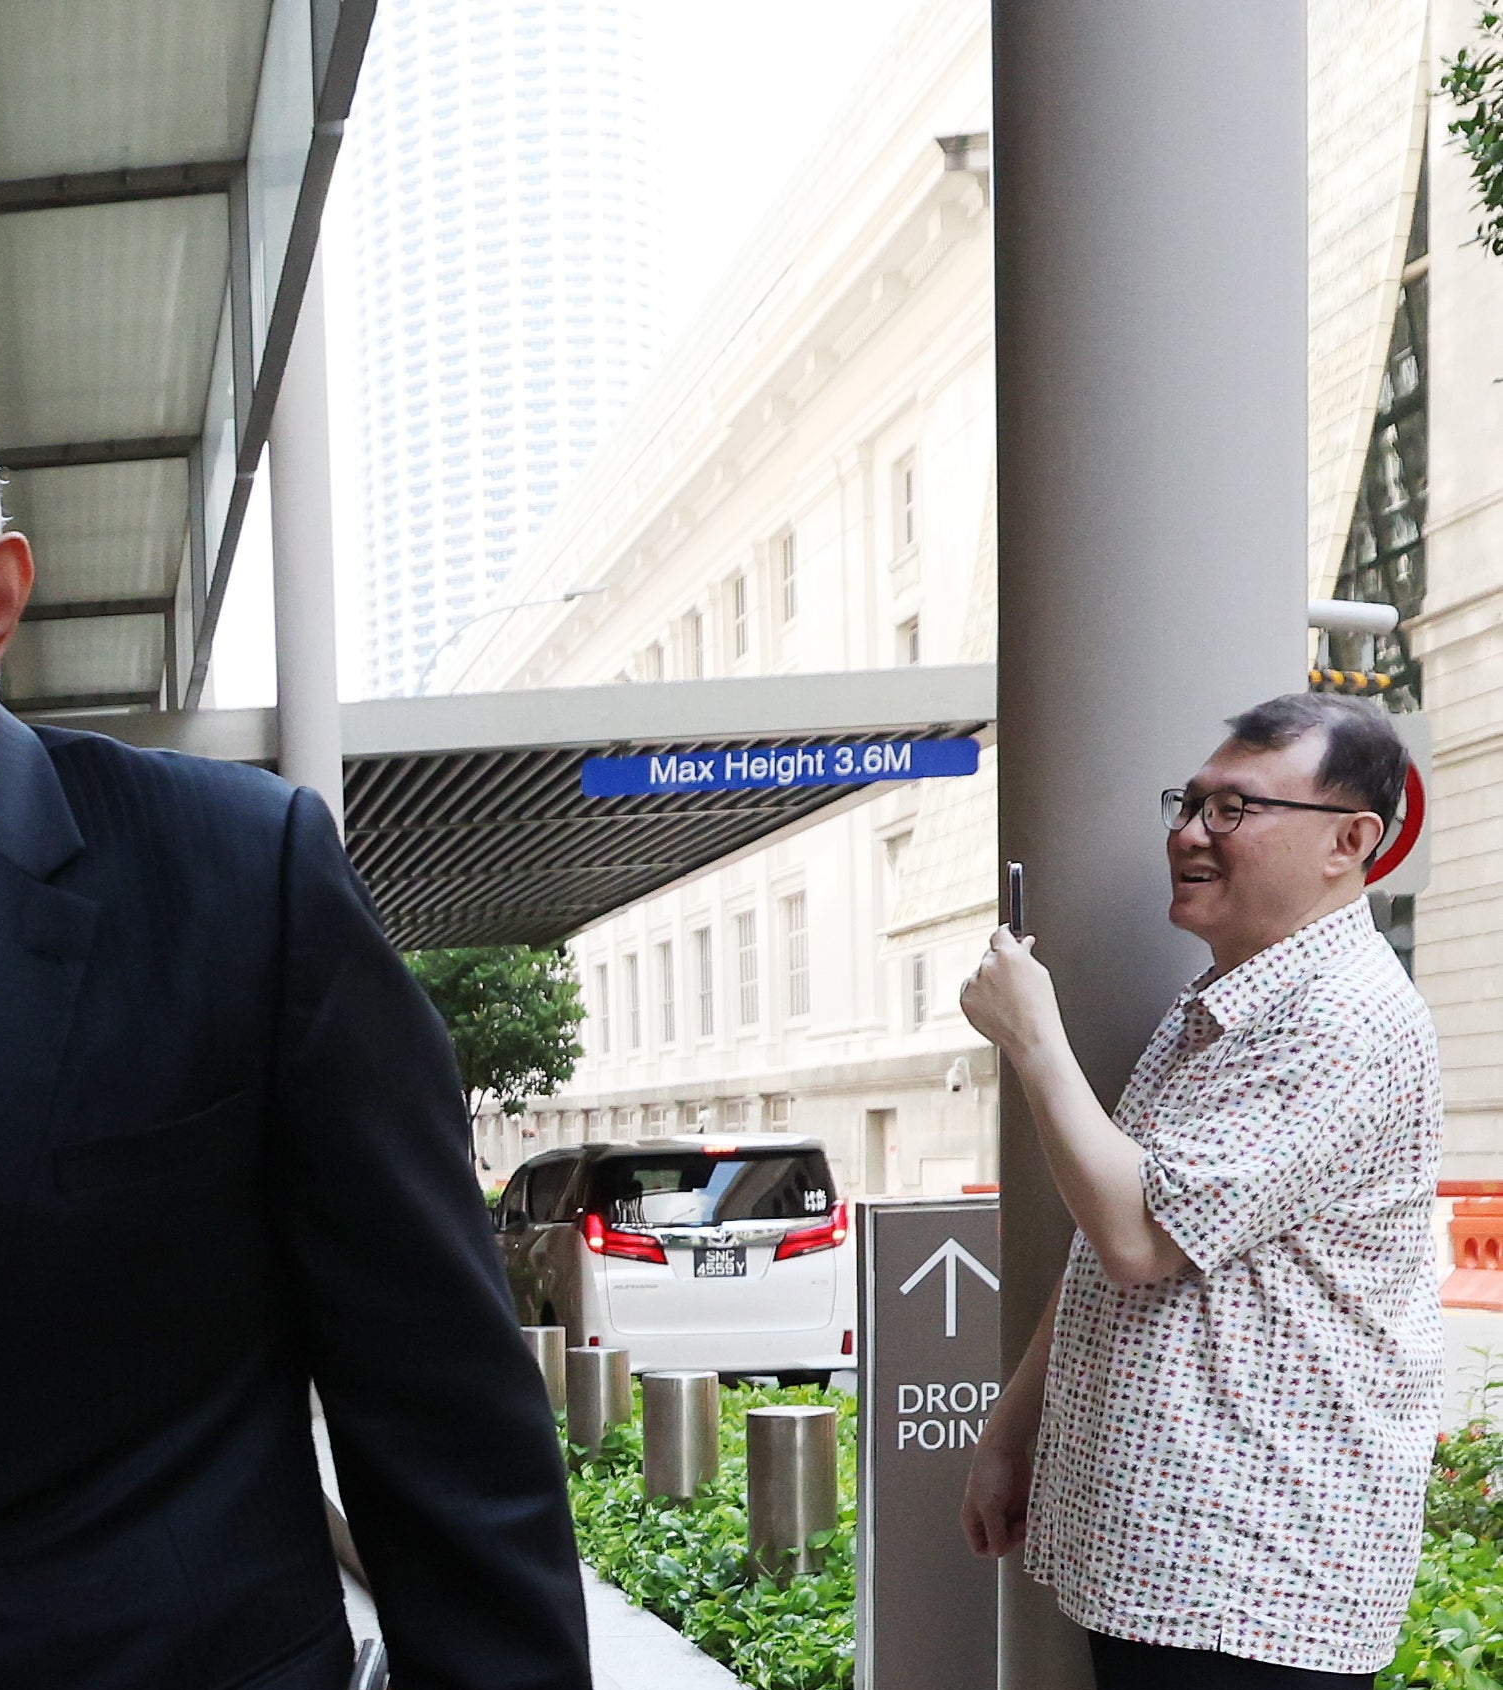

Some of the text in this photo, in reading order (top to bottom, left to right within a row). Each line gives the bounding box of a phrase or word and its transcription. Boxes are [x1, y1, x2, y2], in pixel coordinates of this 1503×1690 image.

[649, 742, 912, 787] Max Height 3.6M
[705, 1249, 736, 1262] SNC
[898, 1382, 1001, 1414] DROP
[898, 1418, 989, 1451] POIN
